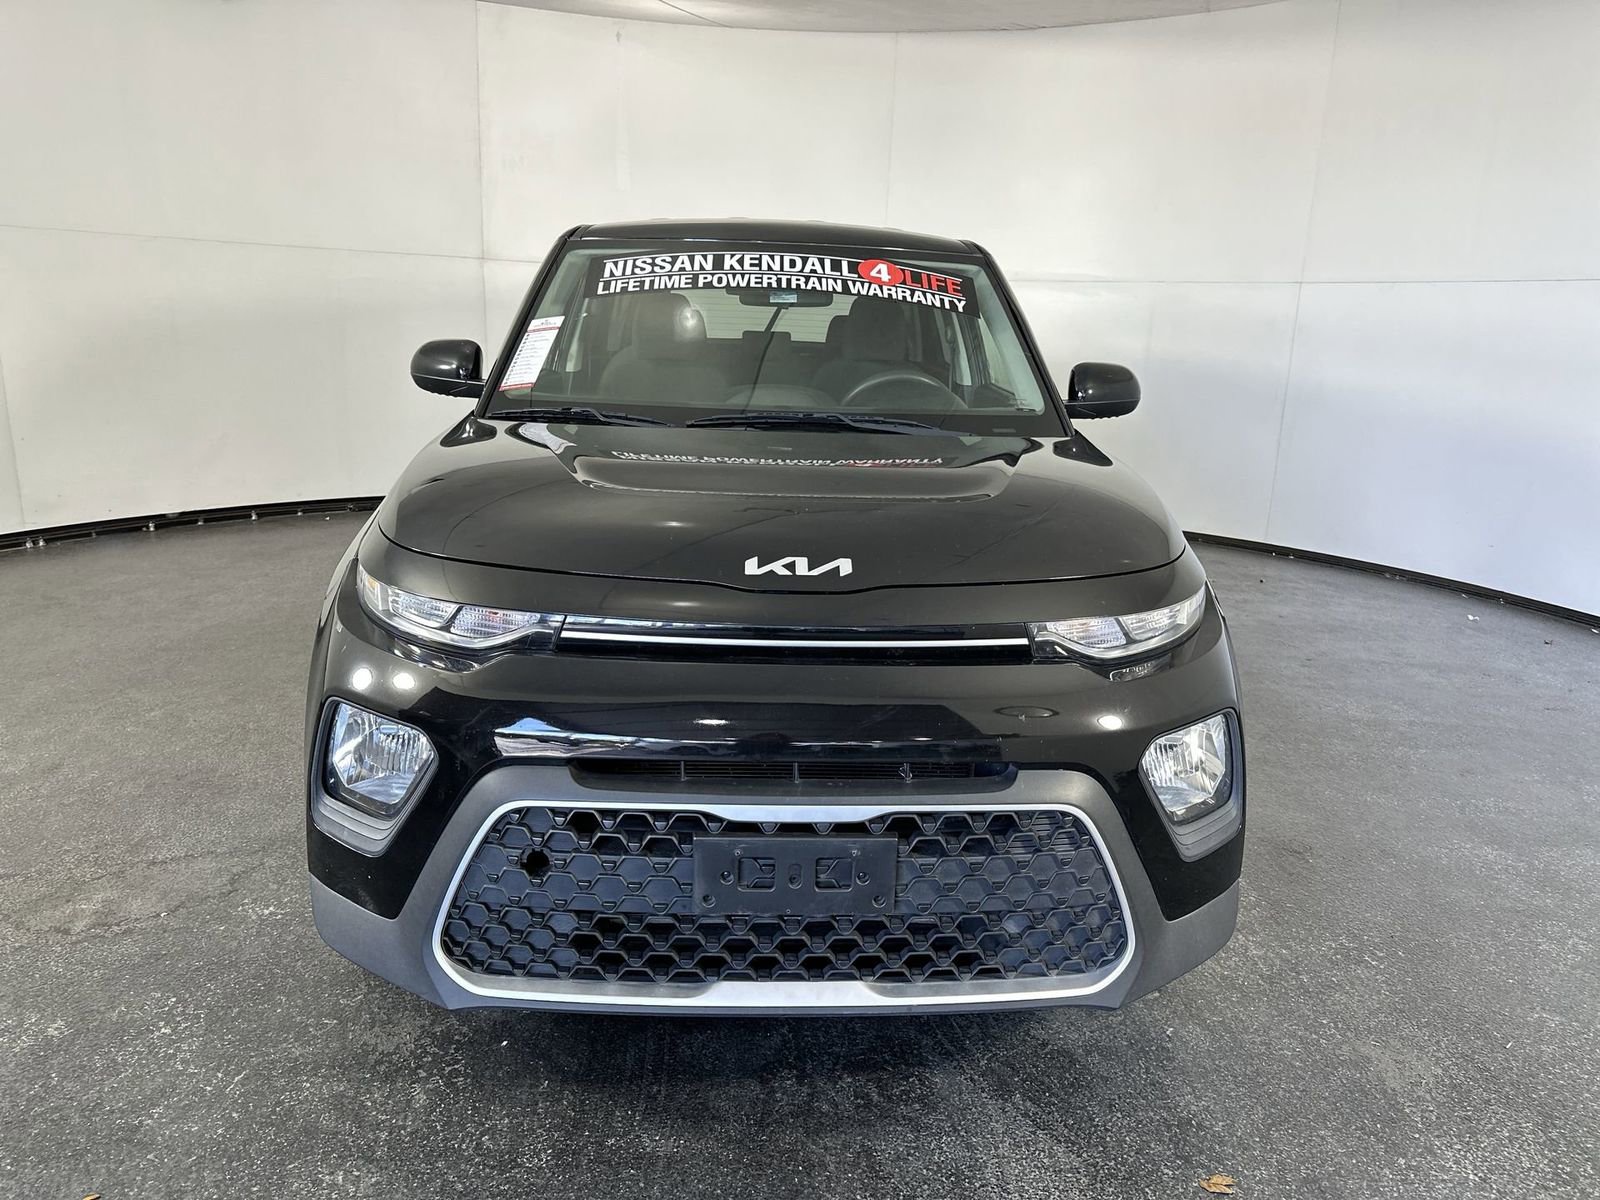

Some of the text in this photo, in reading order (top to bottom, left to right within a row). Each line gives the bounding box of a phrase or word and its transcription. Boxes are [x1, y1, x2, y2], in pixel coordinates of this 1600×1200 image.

[597, 273, 967, 313] LIFETIME POWERTRAIN WARRANTY
[603, 253, 963, 297] NISSAN KENDALL 4 LIFE
[744, 555, 853, 577] KIA
